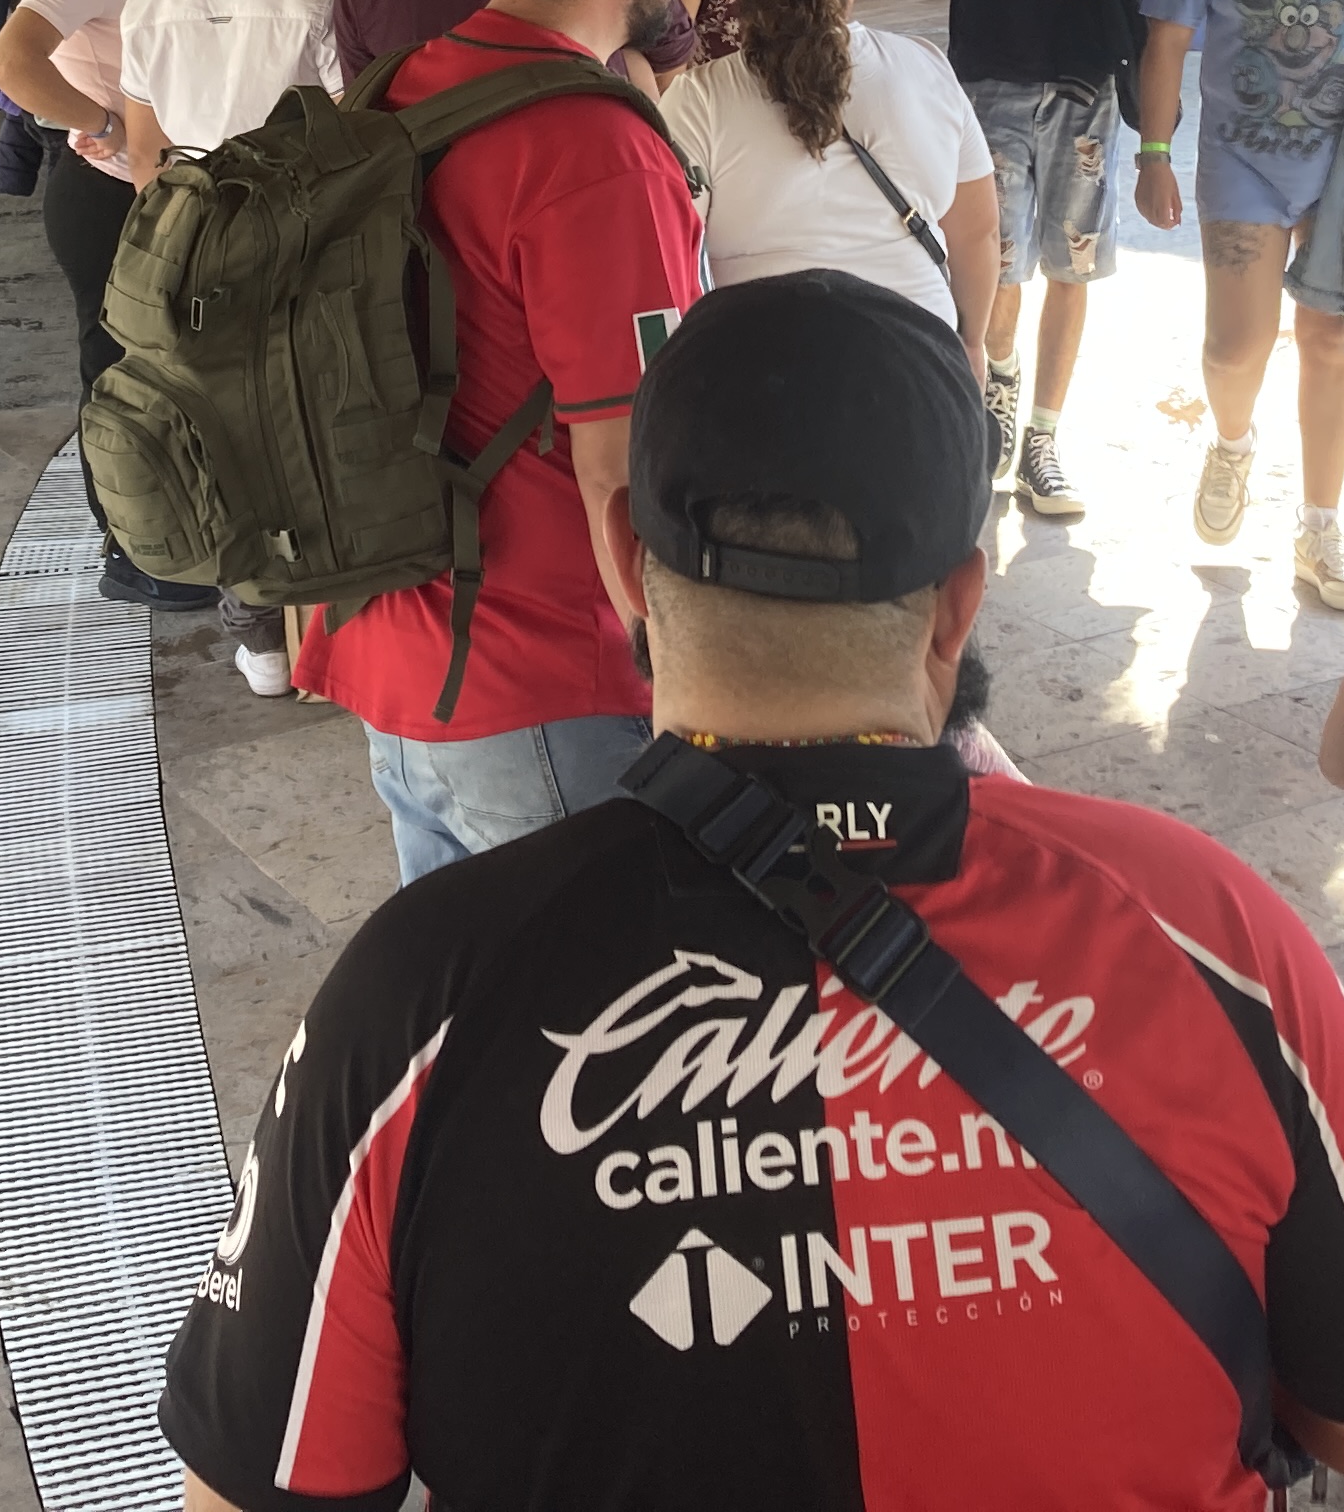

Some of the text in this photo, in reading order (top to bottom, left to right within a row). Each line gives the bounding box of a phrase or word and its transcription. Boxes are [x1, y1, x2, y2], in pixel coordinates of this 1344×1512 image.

[816, 800, 893, 841] RLY
[594, 1109, 1038, 1210] caliente.m
[197, 1258, 243, 1312] Berel
[780, 1210, 1059, 1314] INTER
[788, 1289, 1063, 1340] PROTECCIÓN
